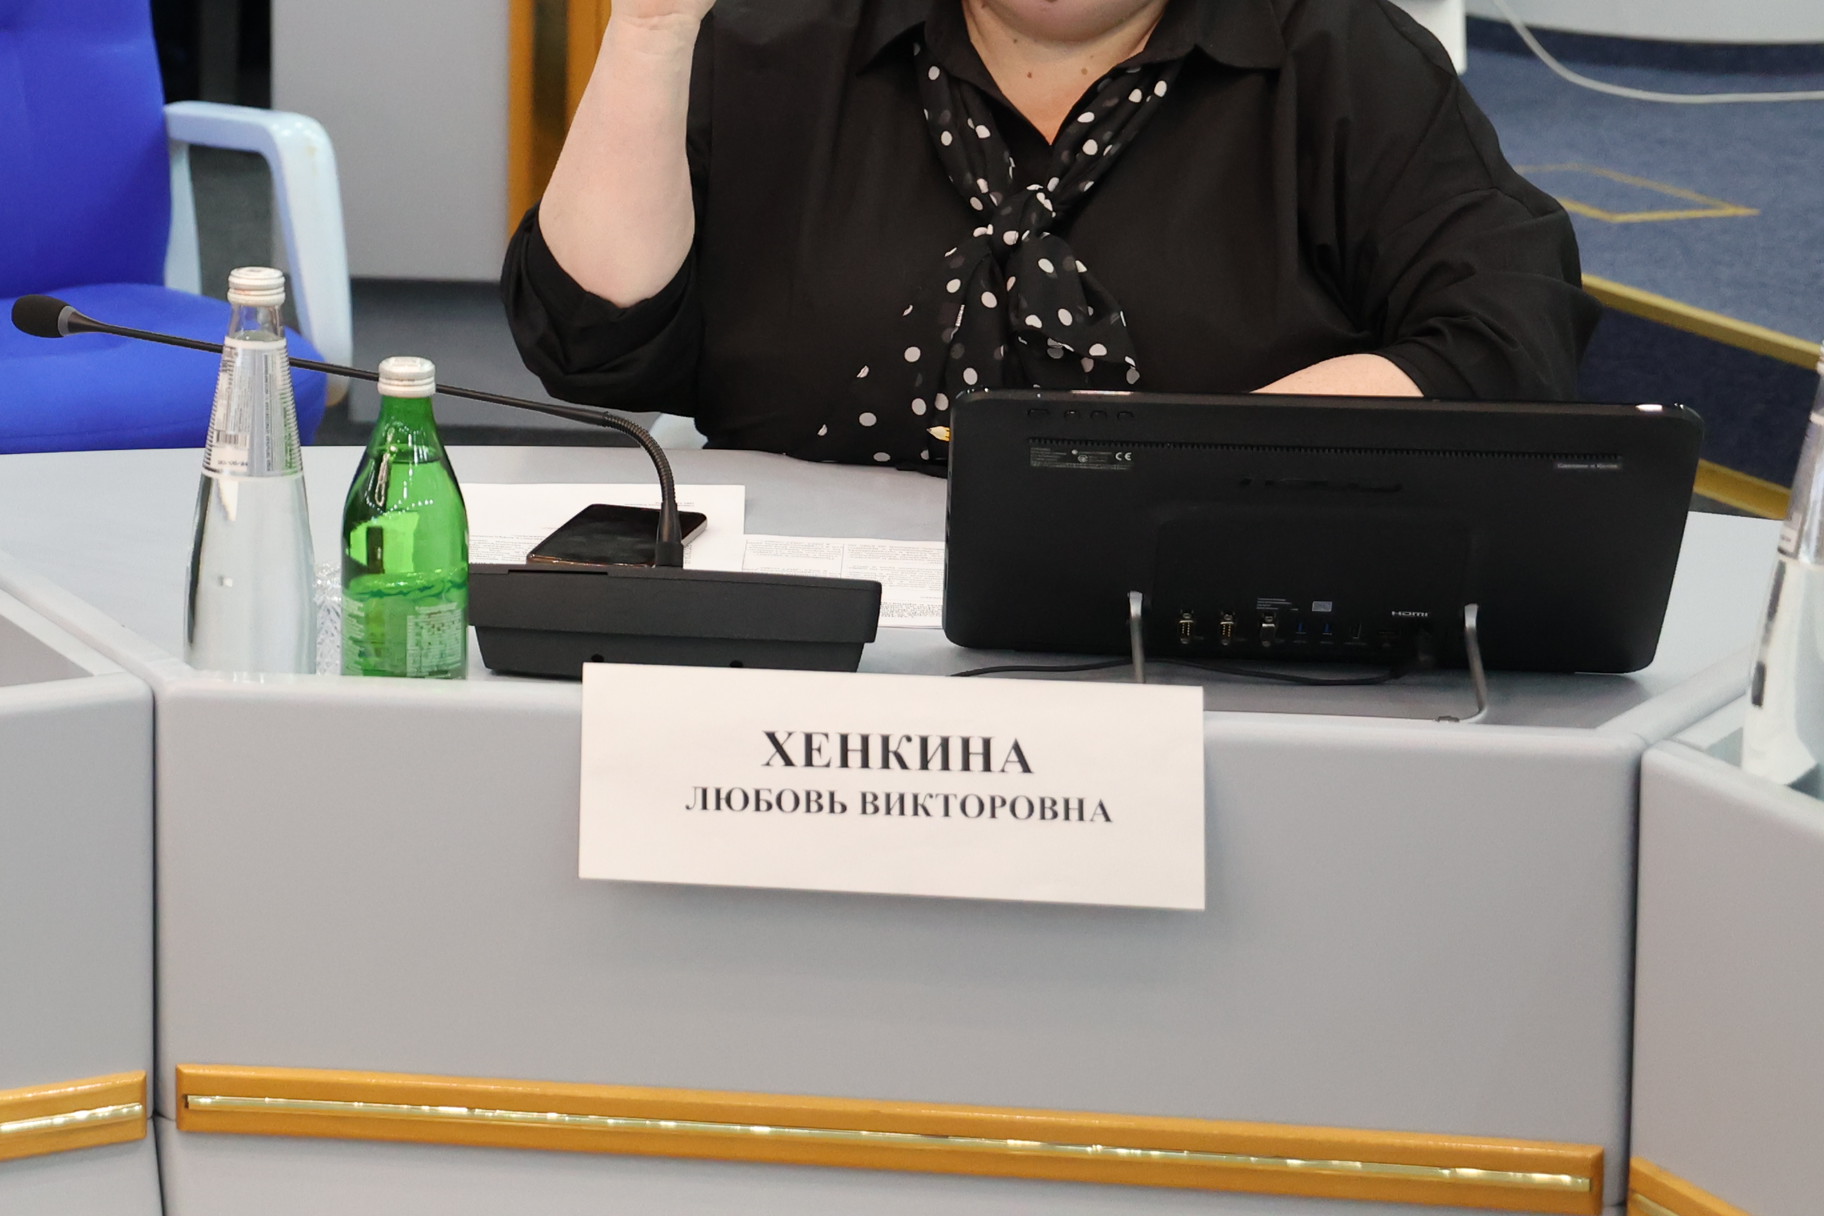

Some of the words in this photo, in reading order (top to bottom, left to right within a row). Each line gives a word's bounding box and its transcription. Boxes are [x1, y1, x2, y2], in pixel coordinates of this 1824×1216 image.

[761, 730, 1034, 775] ХЕНКИНА
[685, 785, 848, 815] ЛЮБОВЬ
[859, 790, 1114, 824] ВИКТОРОВНА
